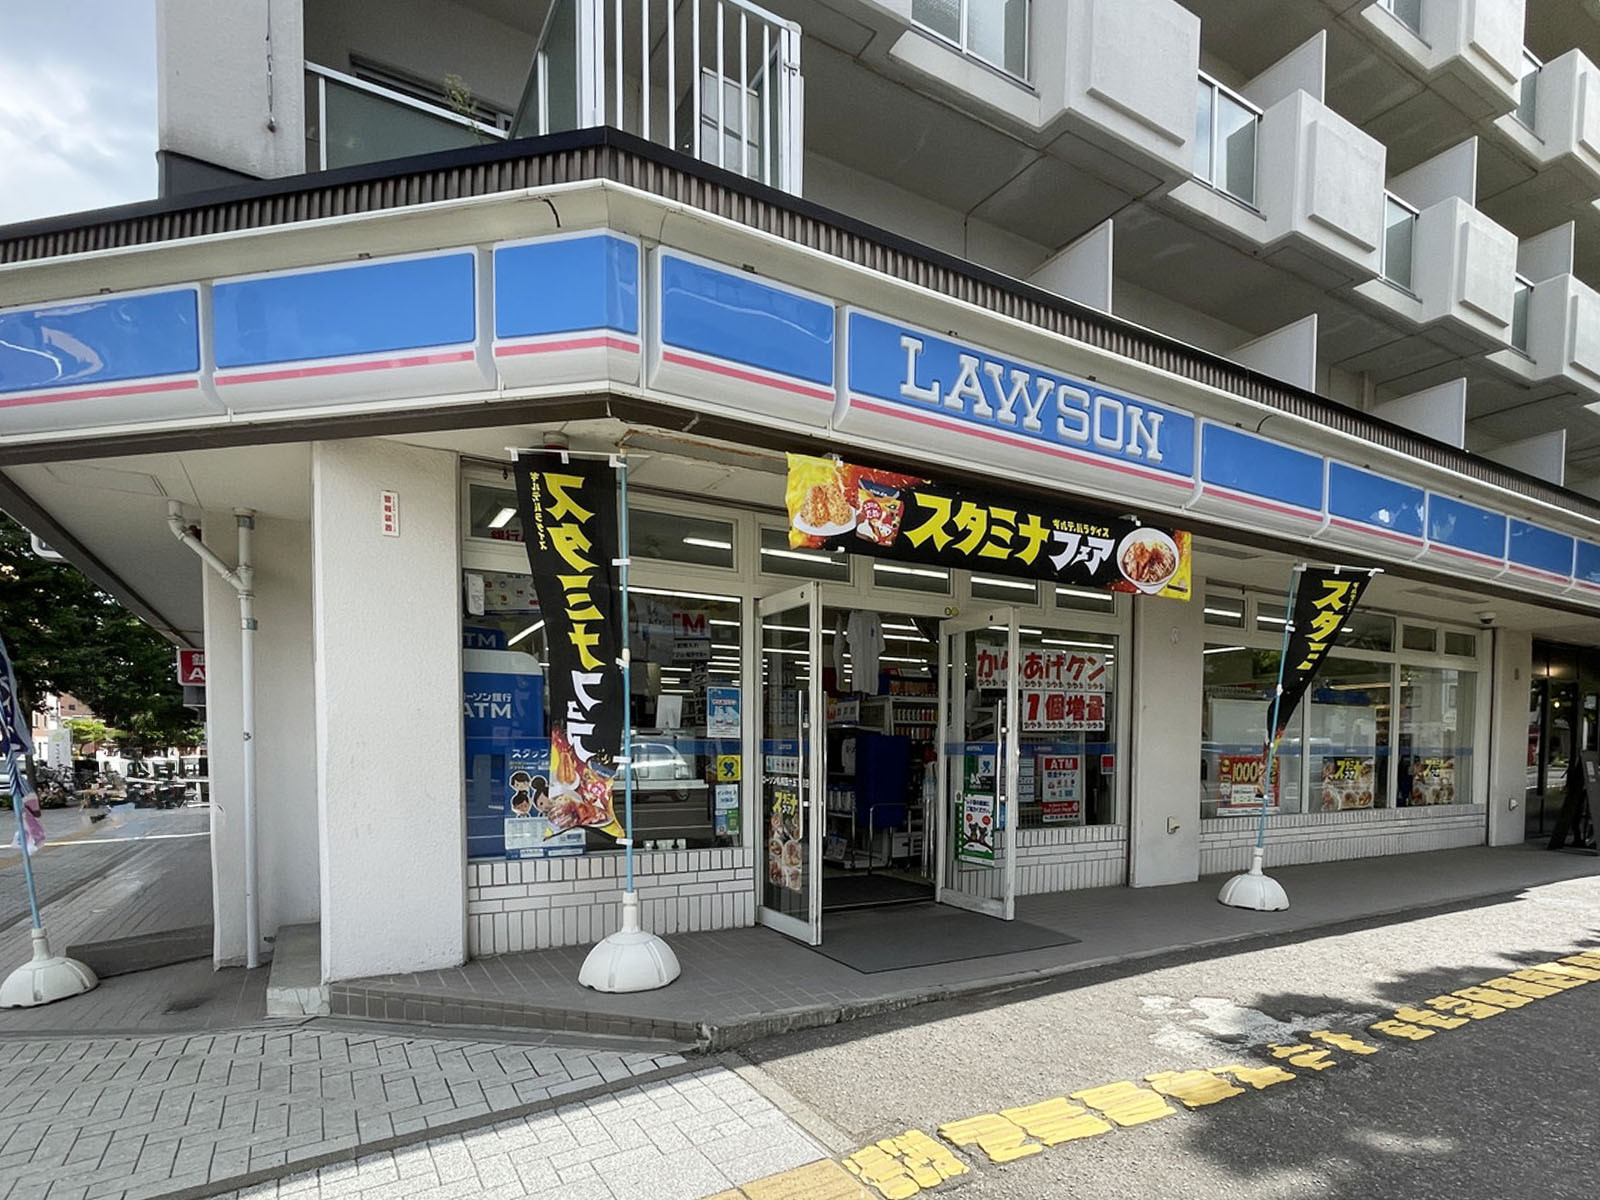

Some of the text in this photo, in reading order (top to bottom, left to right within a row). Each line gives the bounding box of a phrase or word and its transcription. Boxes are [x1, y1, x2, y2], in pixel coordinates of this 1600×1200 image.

[900, 335, 1164, 463] LAWSON
[464, 632, 497, 648] TM
[1026, 693, 1105, 721] 1個増量
[1050, 759, 1073, 769] ATM
